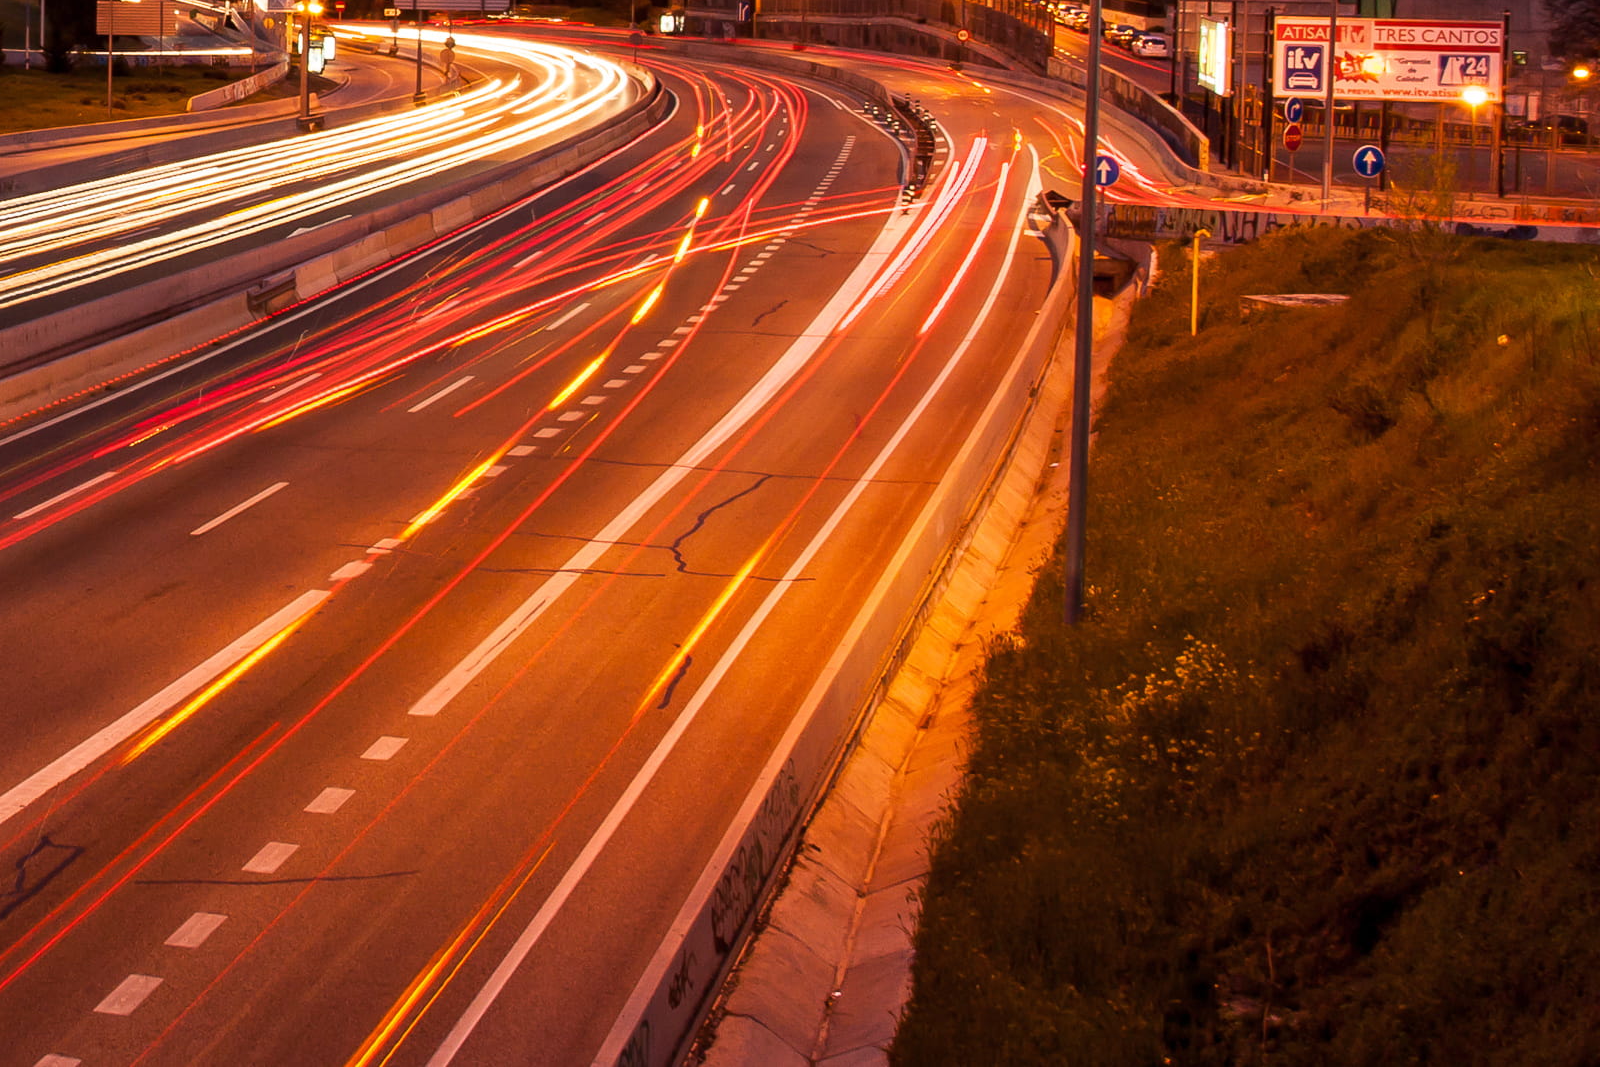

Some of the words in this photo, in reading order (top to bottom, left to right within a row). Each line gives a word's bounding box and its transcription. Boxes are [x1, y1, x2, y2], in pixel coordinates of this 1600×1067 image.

[1282, 26, 1331, 40] ATISA
[1374, 28, 1416, 43] TRES
[1421, 29, 1499, 45] CANTOS
[1287, 47, 1321, 70] itv
[1466, 56, 1488, 76] 24
